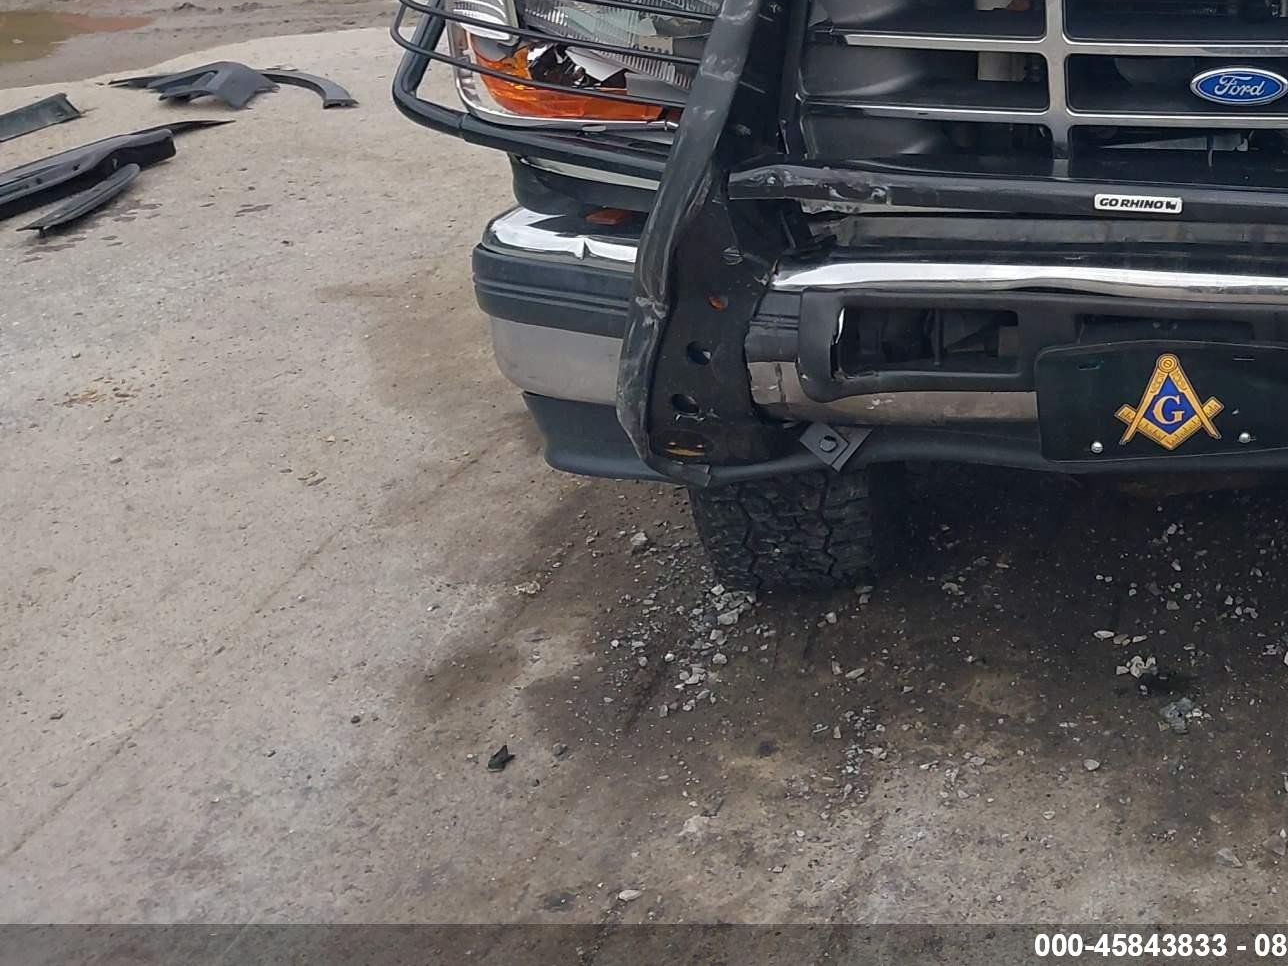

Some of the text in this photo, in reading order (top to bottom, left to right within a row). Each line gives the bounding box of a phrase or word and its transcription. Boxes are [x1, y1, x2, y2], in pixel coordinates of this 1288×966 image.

[1214, 75, 1265, 96] Ford
[1099, 197, 1164, 209] GO RHINO
[1152, 394, 1185, 425] G
